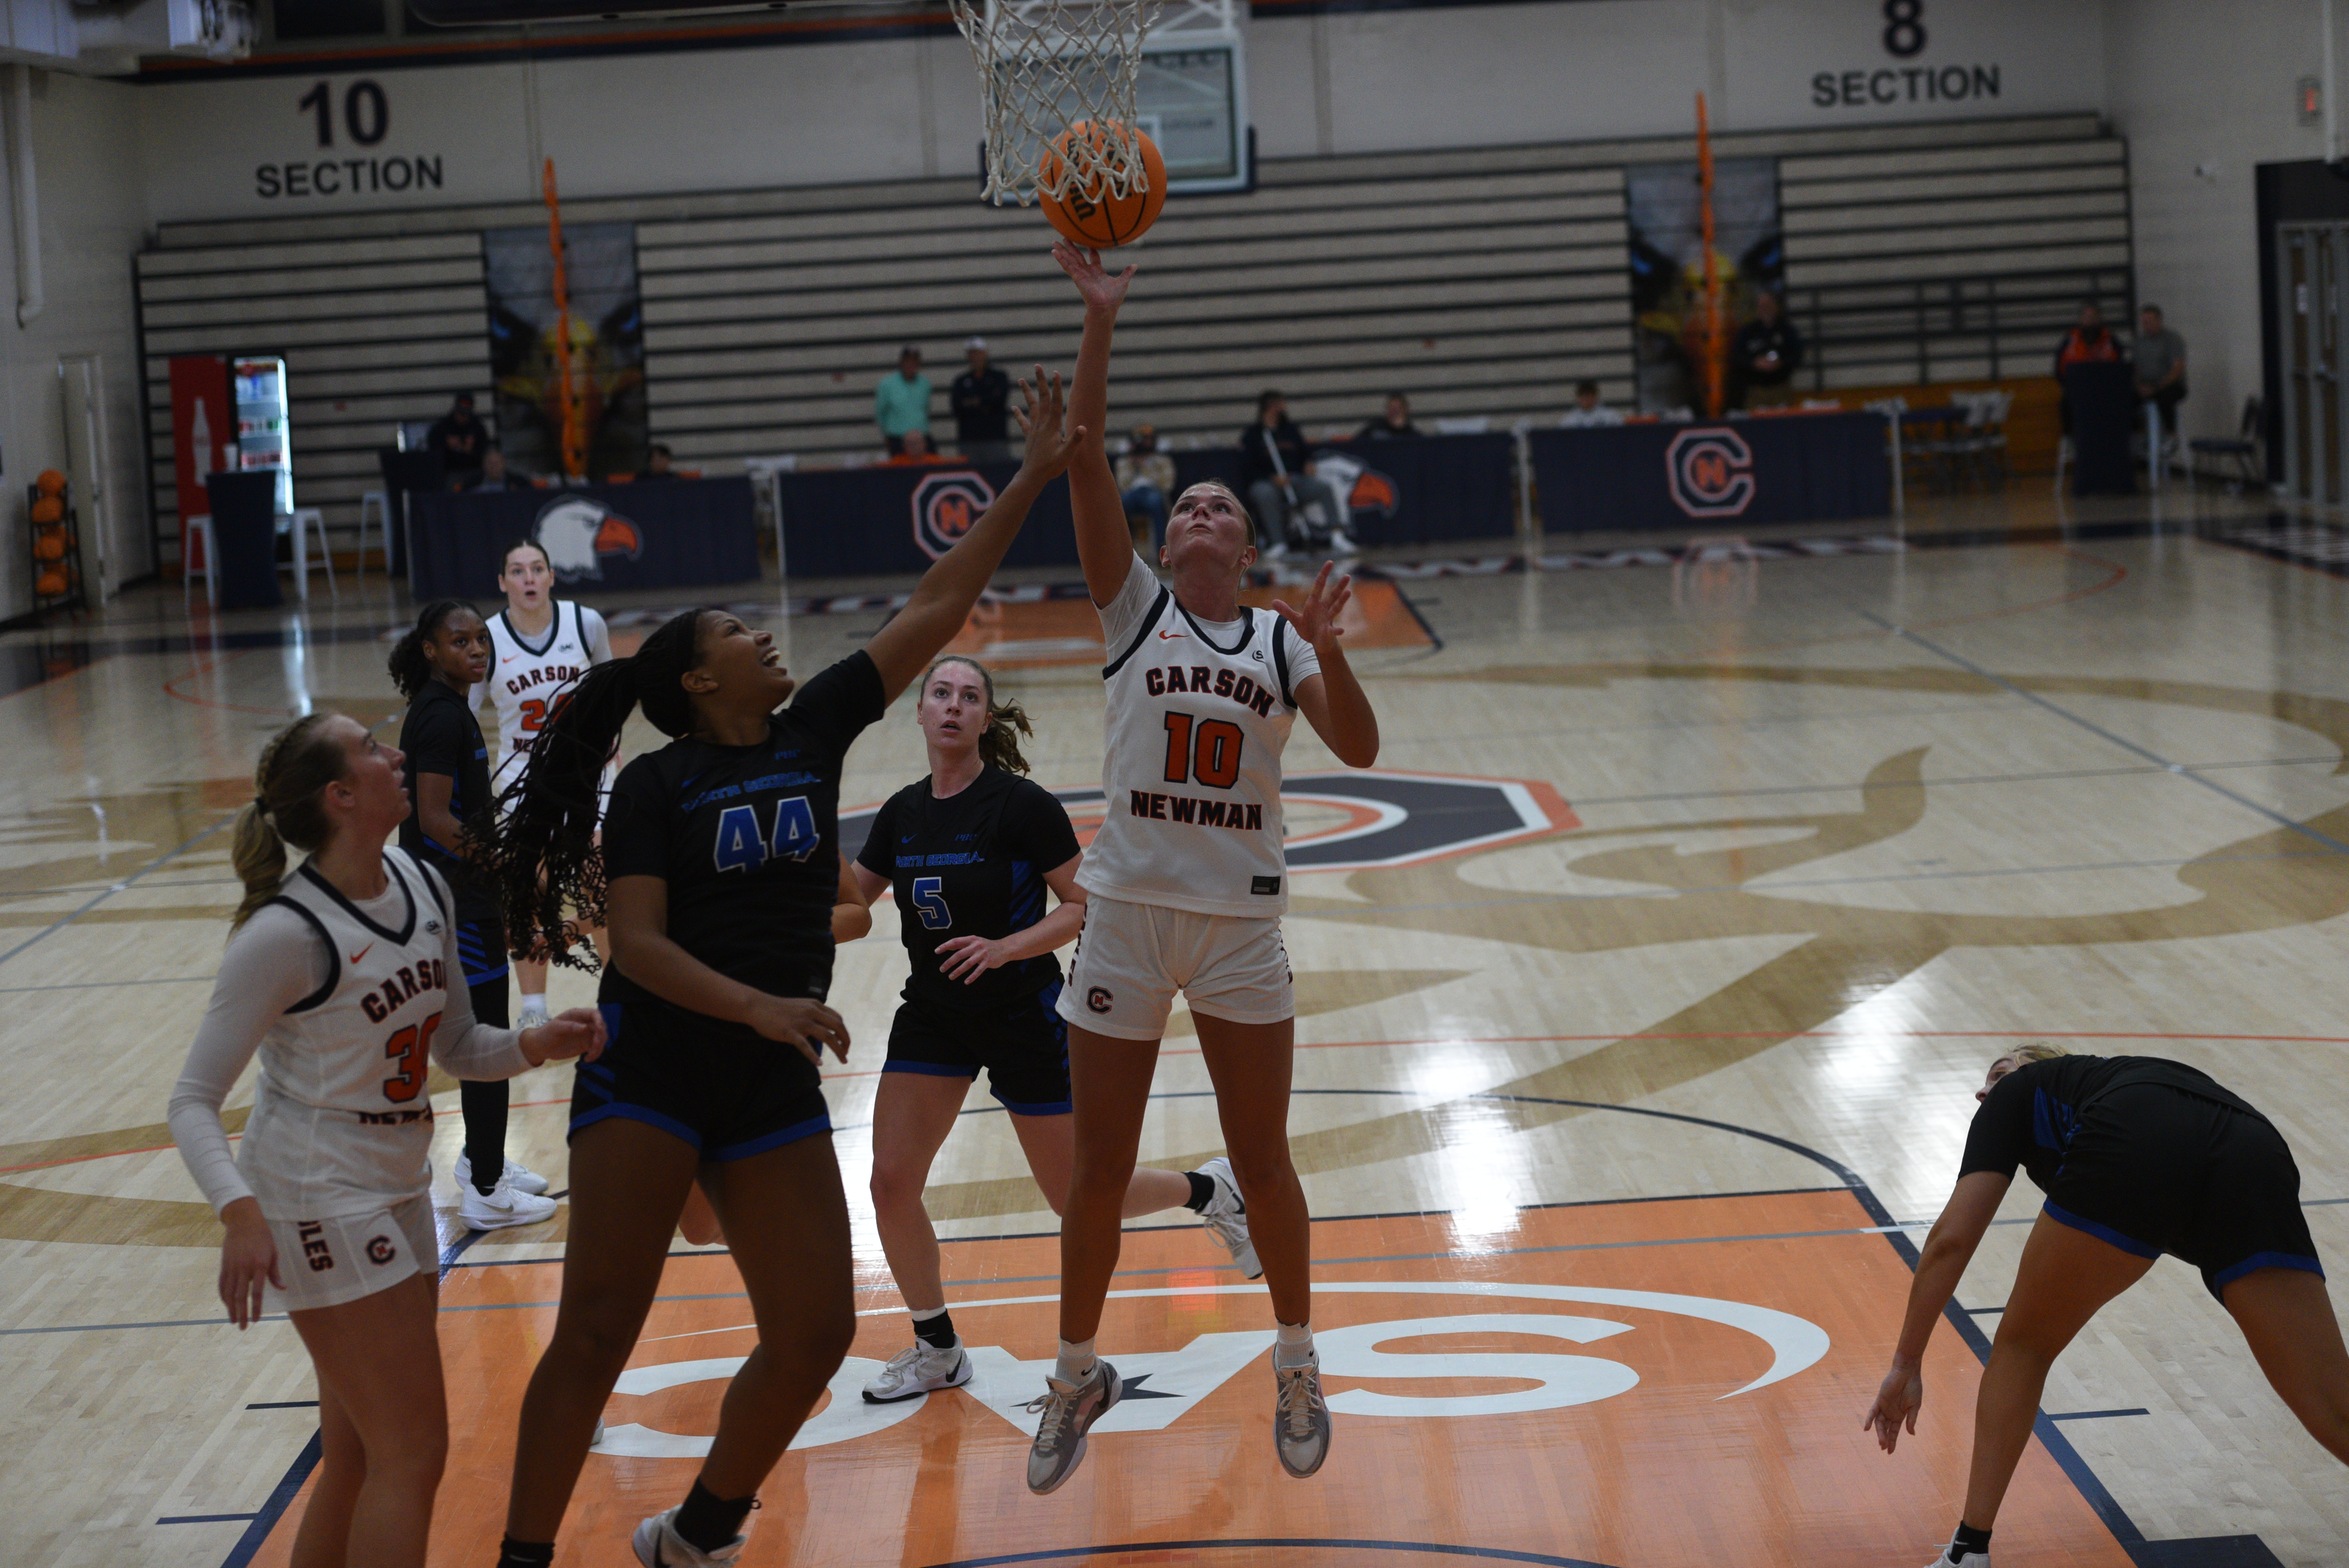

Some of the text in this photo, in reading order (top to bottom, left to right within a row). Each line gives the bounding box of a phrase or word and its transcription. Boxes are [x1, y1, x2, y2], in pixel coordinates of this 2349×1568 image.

[1884, 0, 1927, 57] 8
[1812, 62, 2000, 107] SECTION
[301, 79, 388, 146] 10
[257, 154, 442, 198] SECTION
[506, 665, 581, 695] CARSON
[1146, 665, 1275, 719] CARSON
[1164, 710, 1244, 789] 10
[713, 795, 820, 873] 44
[1130, 789, 1262, 830] NEWMAN
[926, 850, 984, 867] GEORGIA
[912, 876, 953, 930] 5
